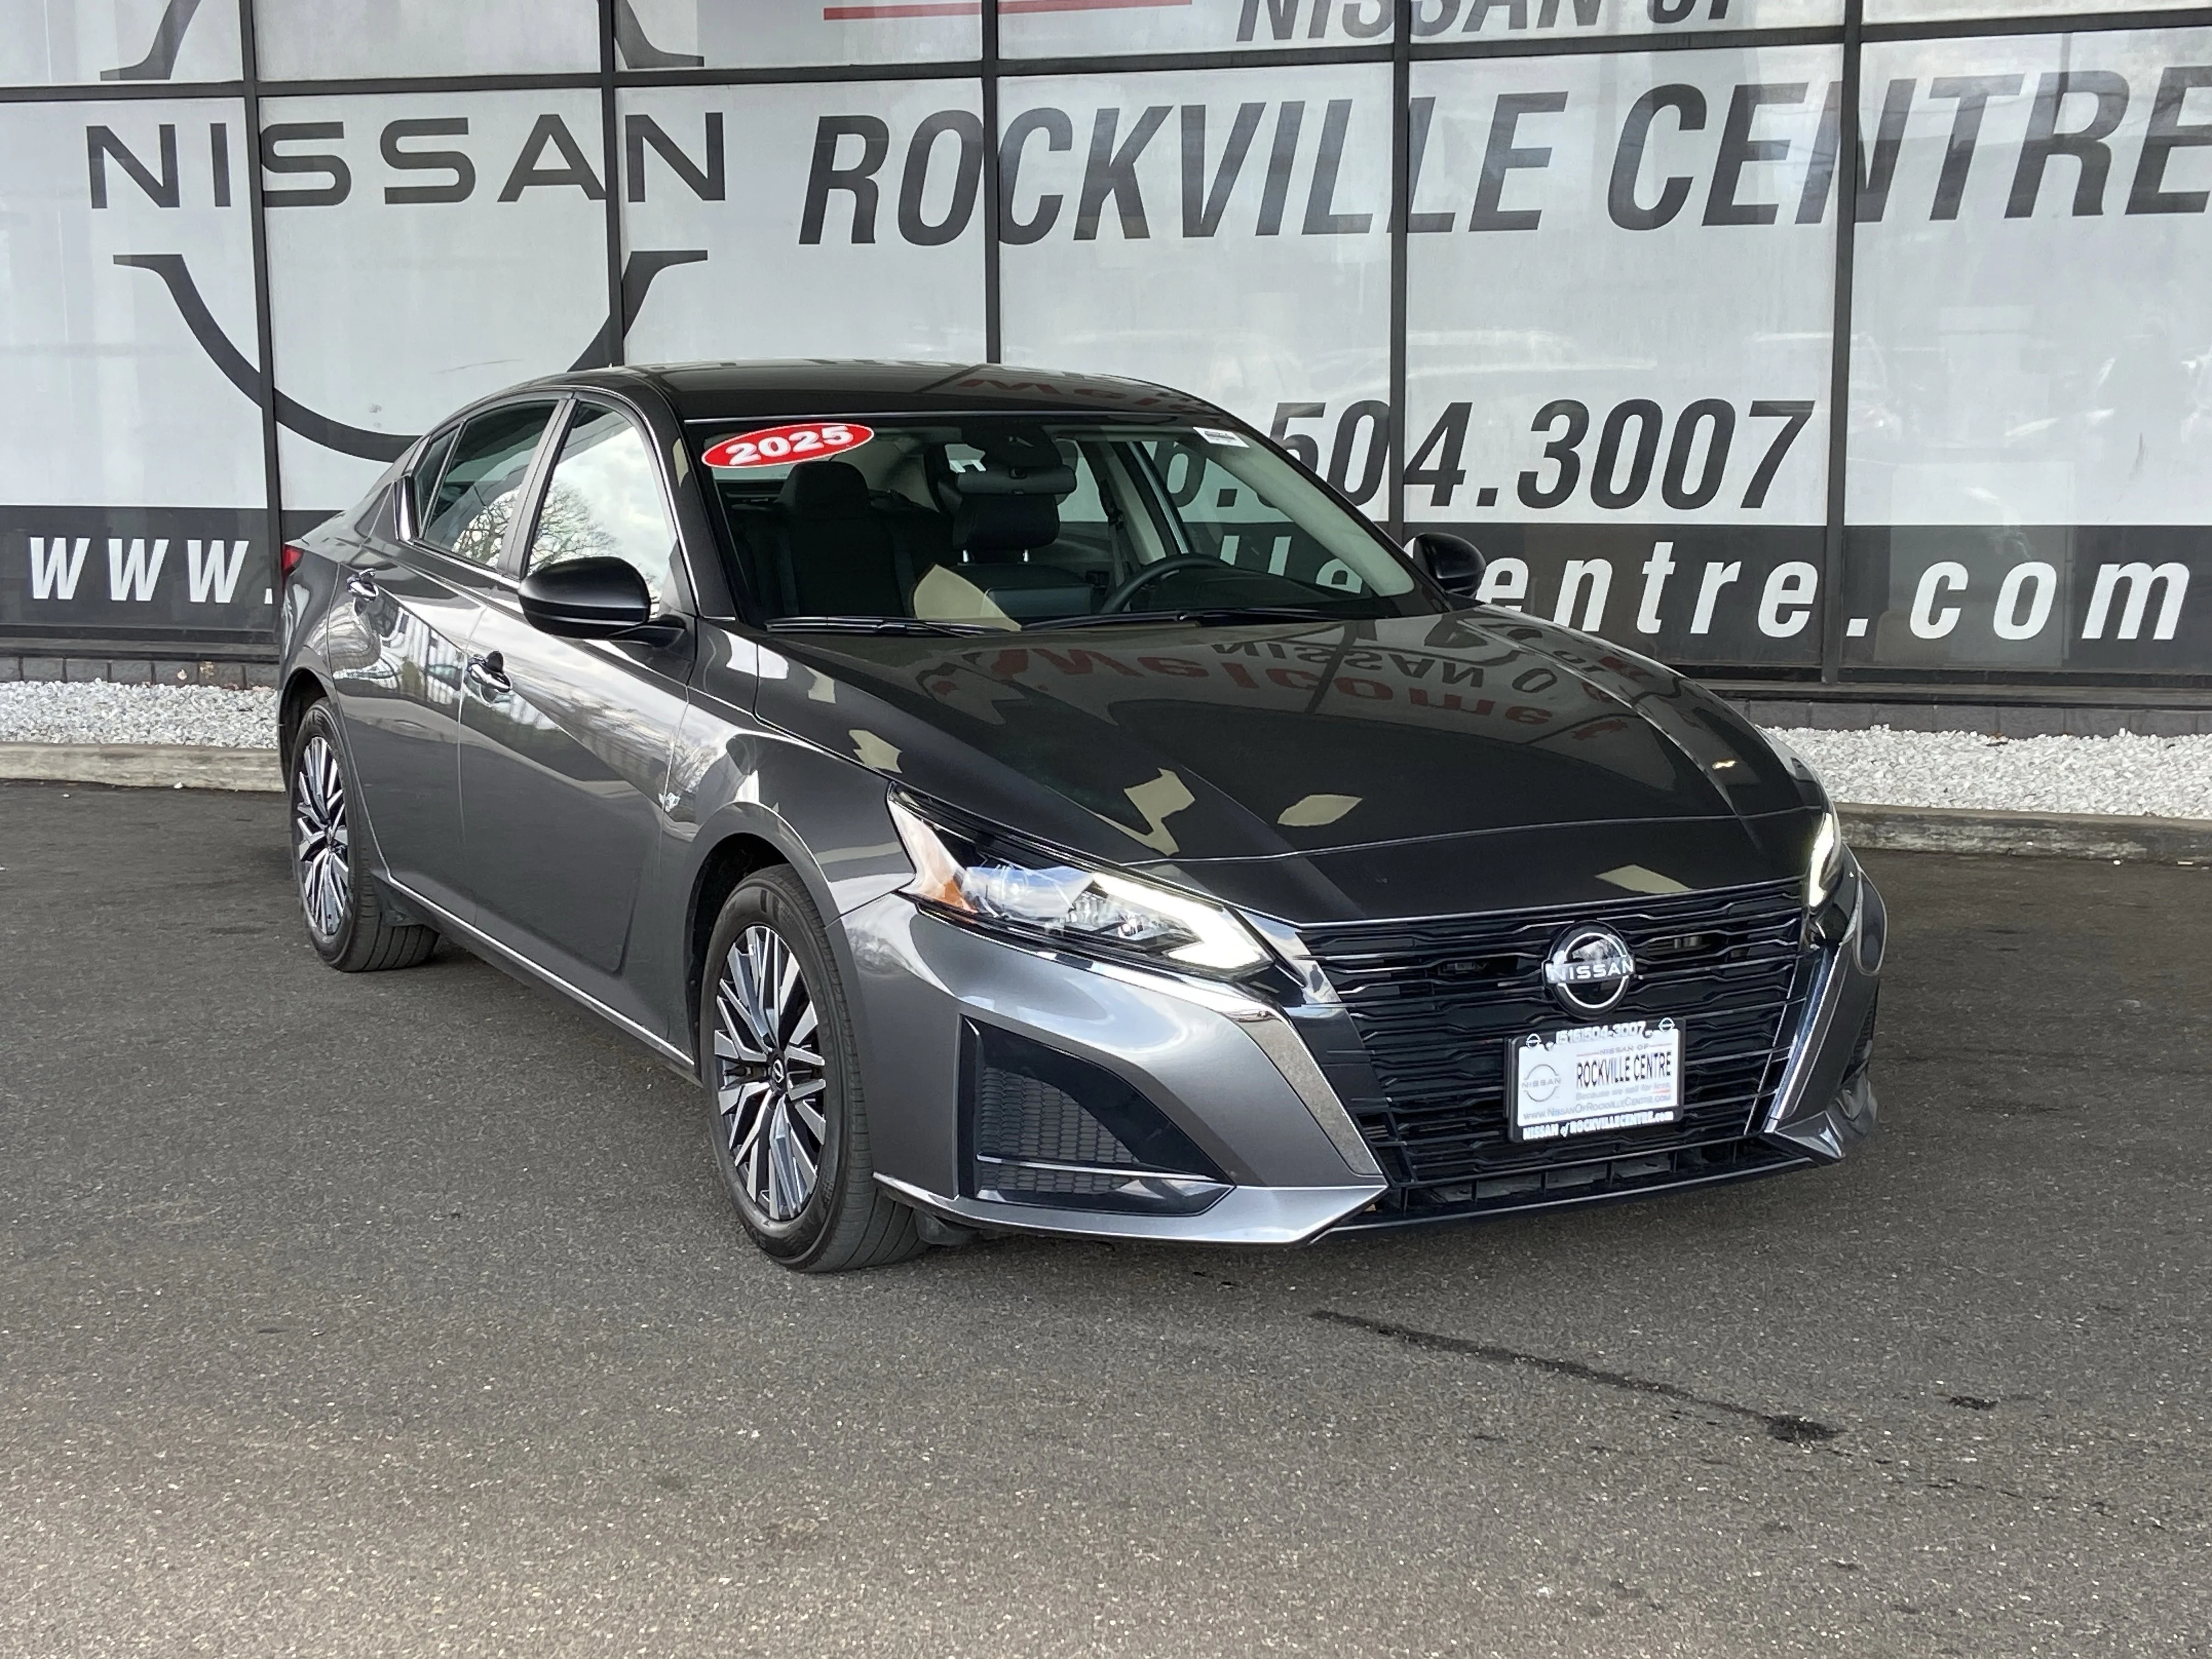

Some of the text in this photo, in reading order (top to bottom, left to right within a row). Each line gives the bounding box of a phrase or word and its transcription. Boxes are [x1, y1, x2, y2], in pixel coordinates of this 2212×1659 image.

[86, 112, 726, 210] NISSAN
[798, 64, 2212, 246] ROCKVILLE CENTRE
[725, 425, 854, 466] 2025
[1547, 960, 1634, 981] NISSAN
[1599, 1045, 1634, 1055] NISSAN
[1521, 1077, 1561, 1089] NISSAN
[1576, 1050, 1672, 1089] ROCKVILLE CENTRE
[1523, 1124, 1559, 1140] NISSAN
